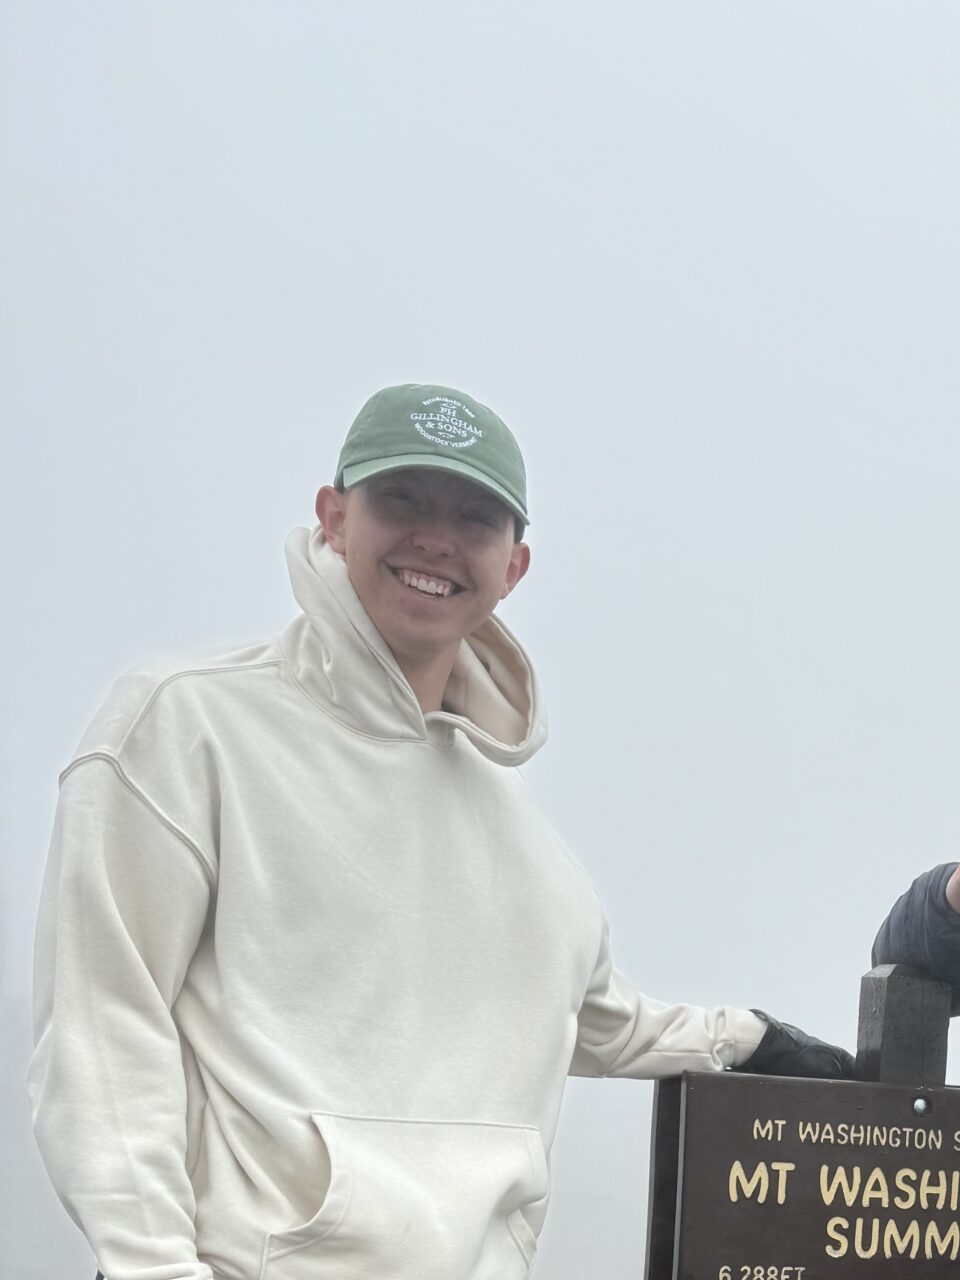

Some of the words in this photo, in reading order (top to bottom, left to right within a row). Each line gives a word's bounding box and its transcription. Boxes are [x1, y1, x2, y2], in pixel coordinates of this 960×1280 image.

[410, 412, 483, 438] GILLINGHAM
[425, 421, 435, 429] &
[437, 421, 468, 437] SONS
[752, 1118, 787, 1142] MT
[799, 1121, 943, 1150] WASHINGTON
[728, 1160, 796, 1205] MT
